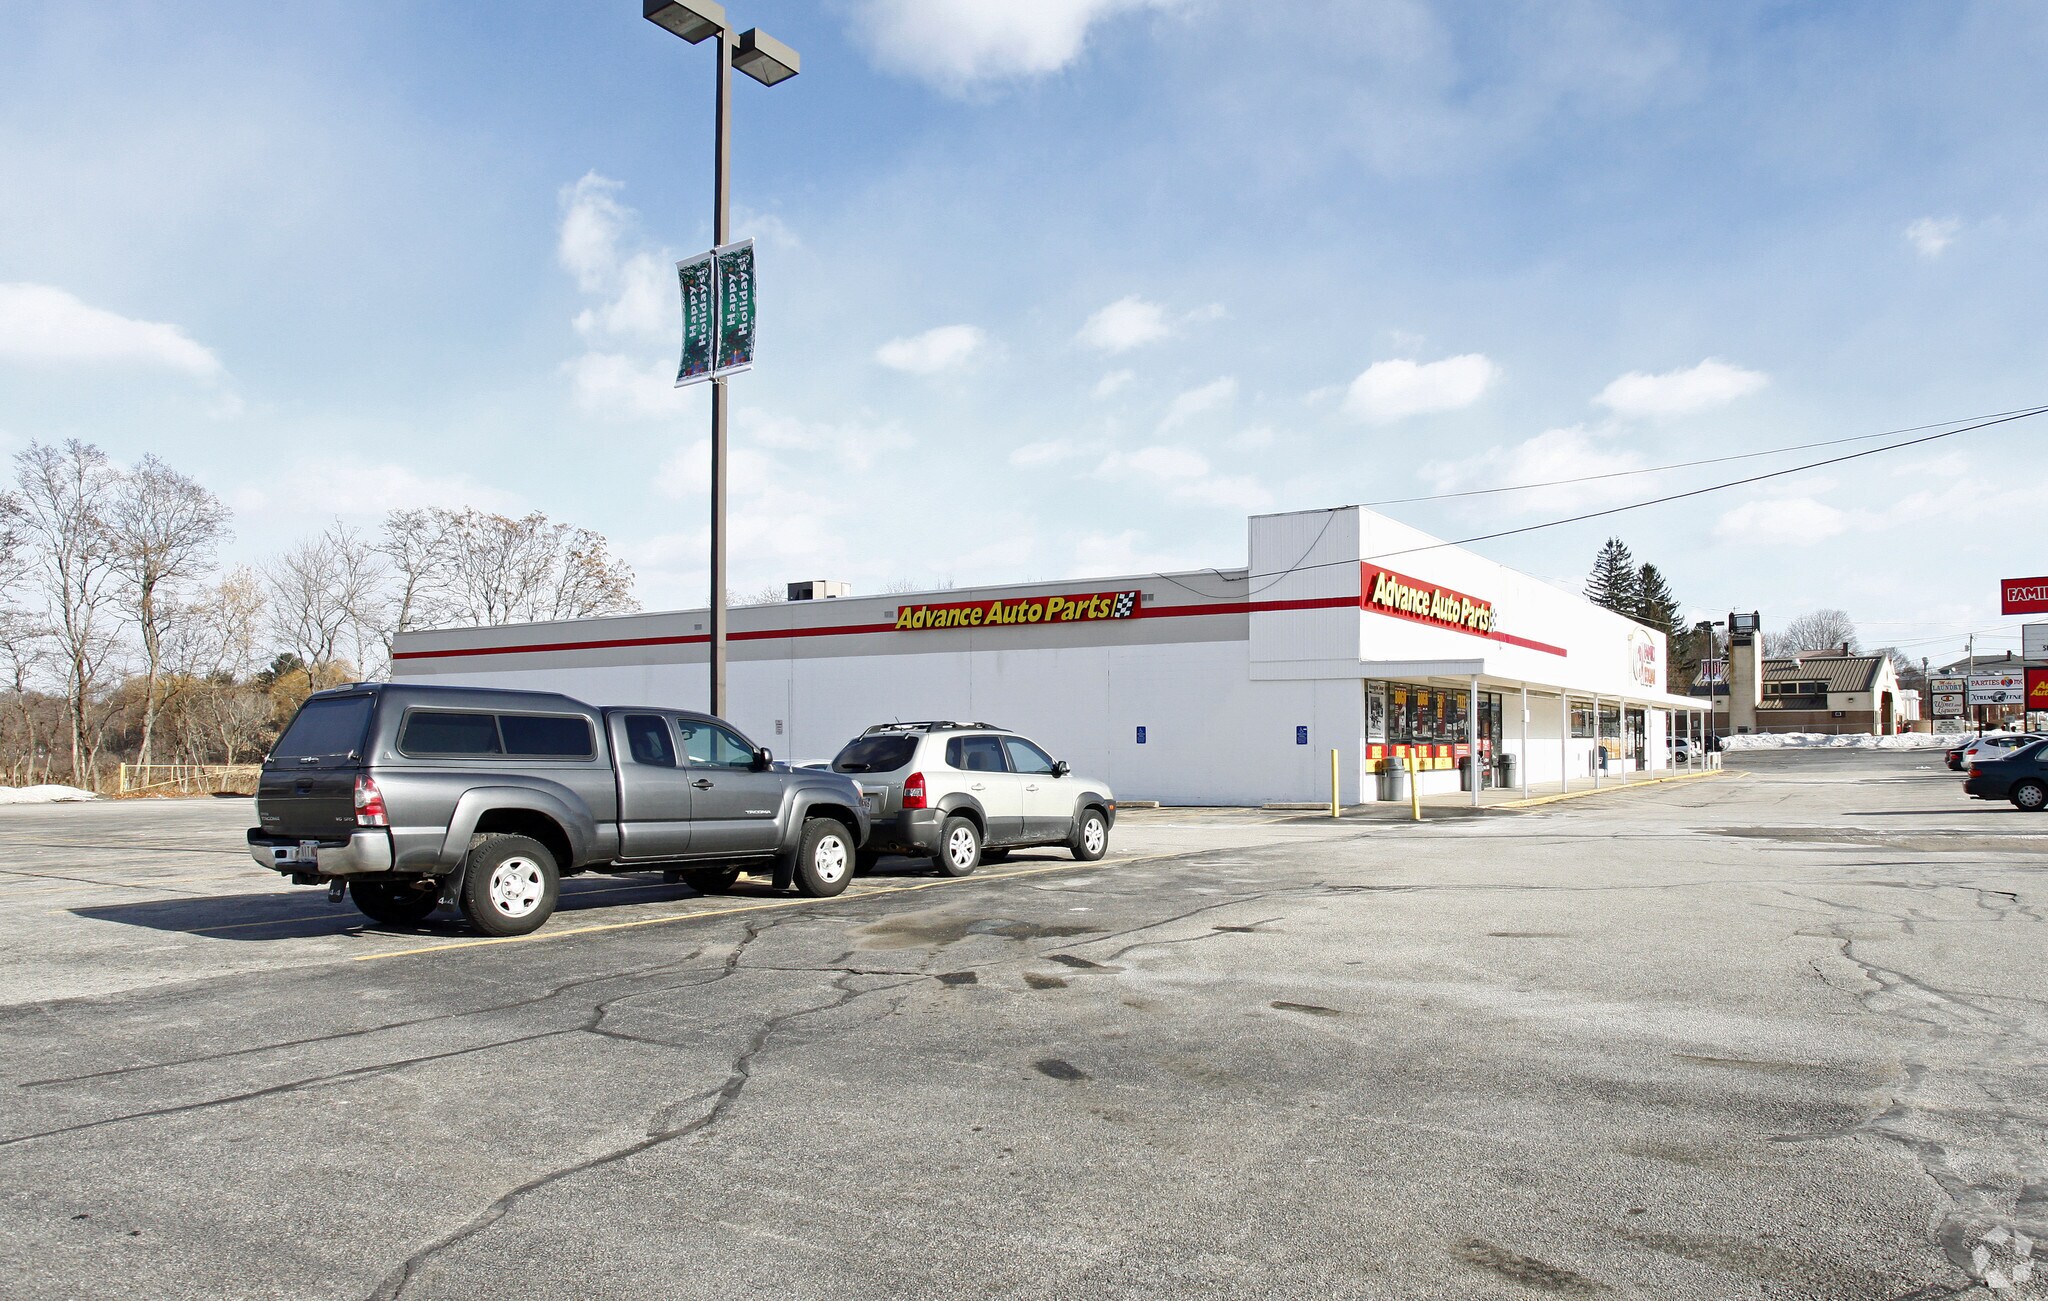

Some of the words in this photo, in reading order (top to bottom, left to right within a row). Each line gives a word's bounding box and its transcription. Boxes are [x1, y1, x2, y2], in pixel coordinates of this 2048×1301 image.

[689, 286, 697, 338] Happy
[727, 273, 737, 326] Happy
[895, 605, 982, 629] Advance
[983, 601, 1043, 625] Auto
[1044, 594, 1112, 621] Parts
[1372, 571, 1430, 616] Advance
[1429, 588, 1461, 624] Auto
[1460, 597, 1490, 631] Parts
[1971, 679, 2000, 687] PARTIES
